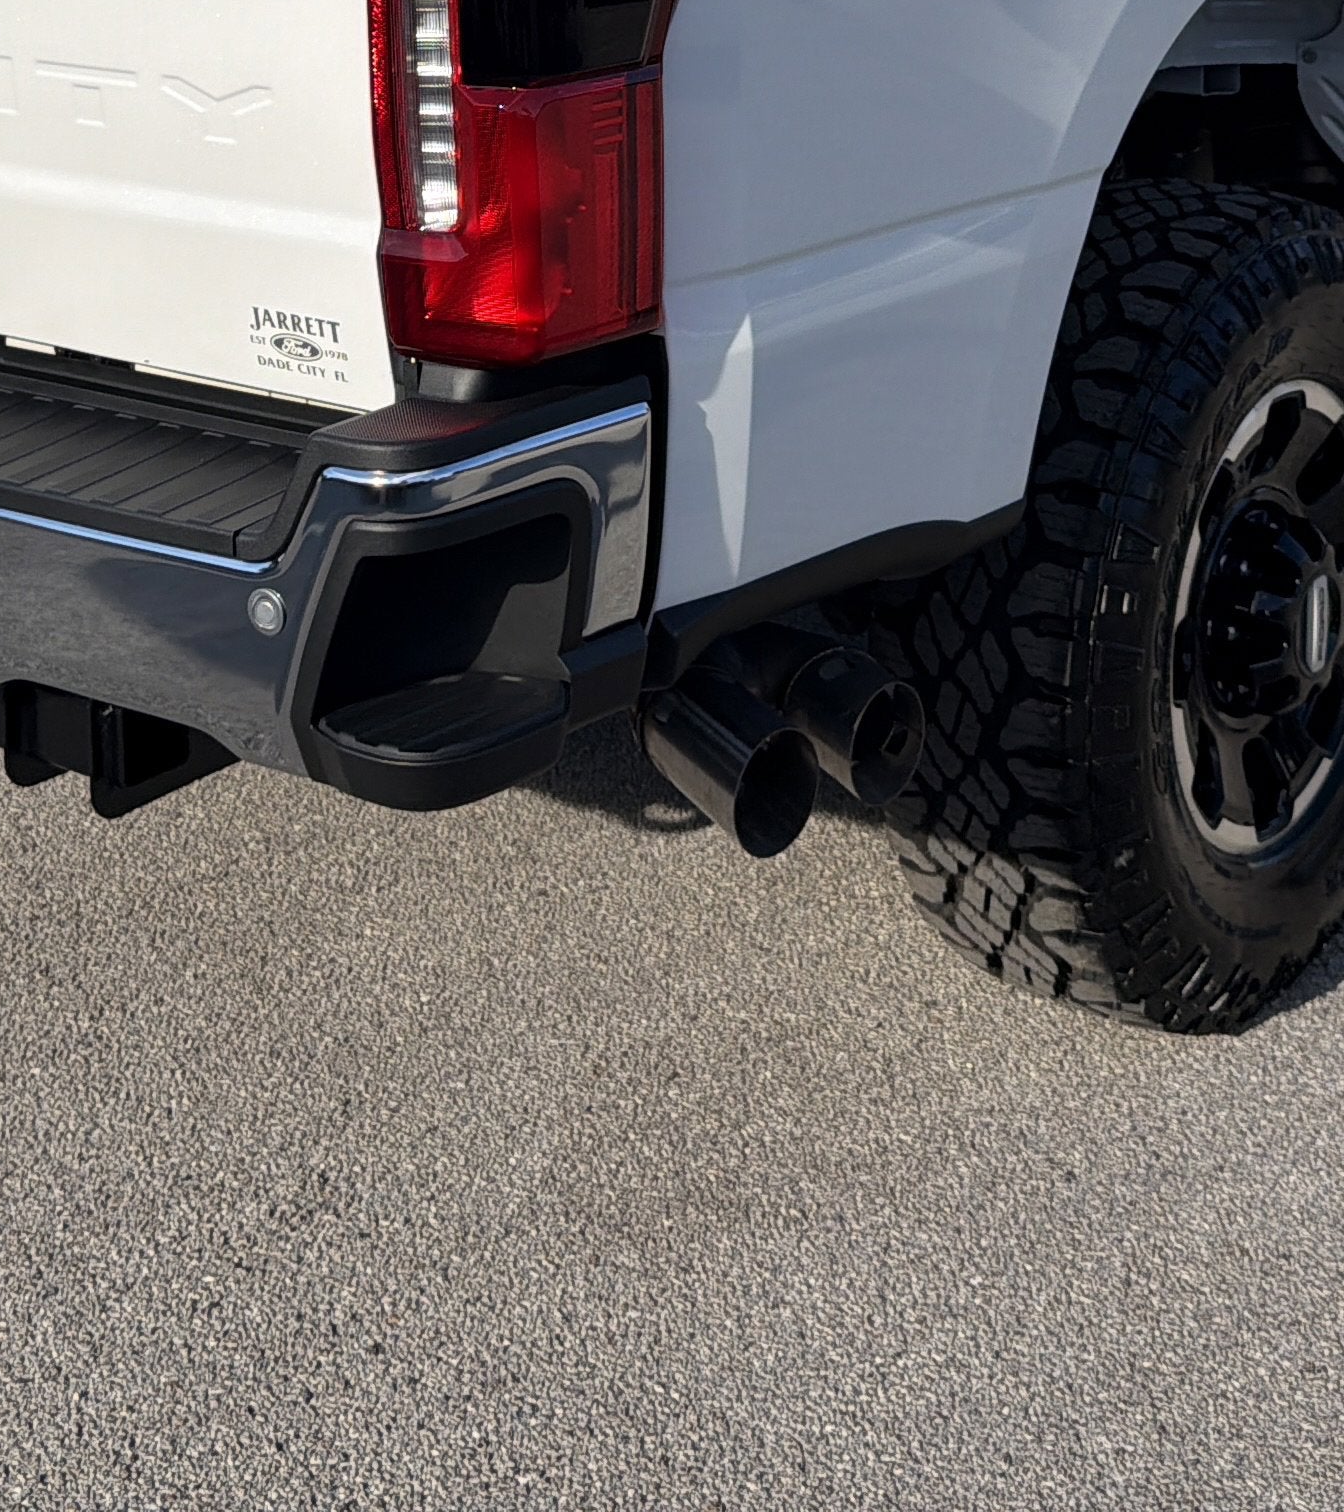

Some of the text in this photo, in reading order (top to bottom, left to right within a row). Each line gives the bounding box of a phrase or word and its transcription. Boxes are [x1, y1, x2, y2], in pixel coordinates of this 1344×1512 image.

[249, 306, 340, 344] JARRETT
[249, 334, 349, 362] EST Ford 1978
[257, 354, 349, 383] DADE CITY FL
